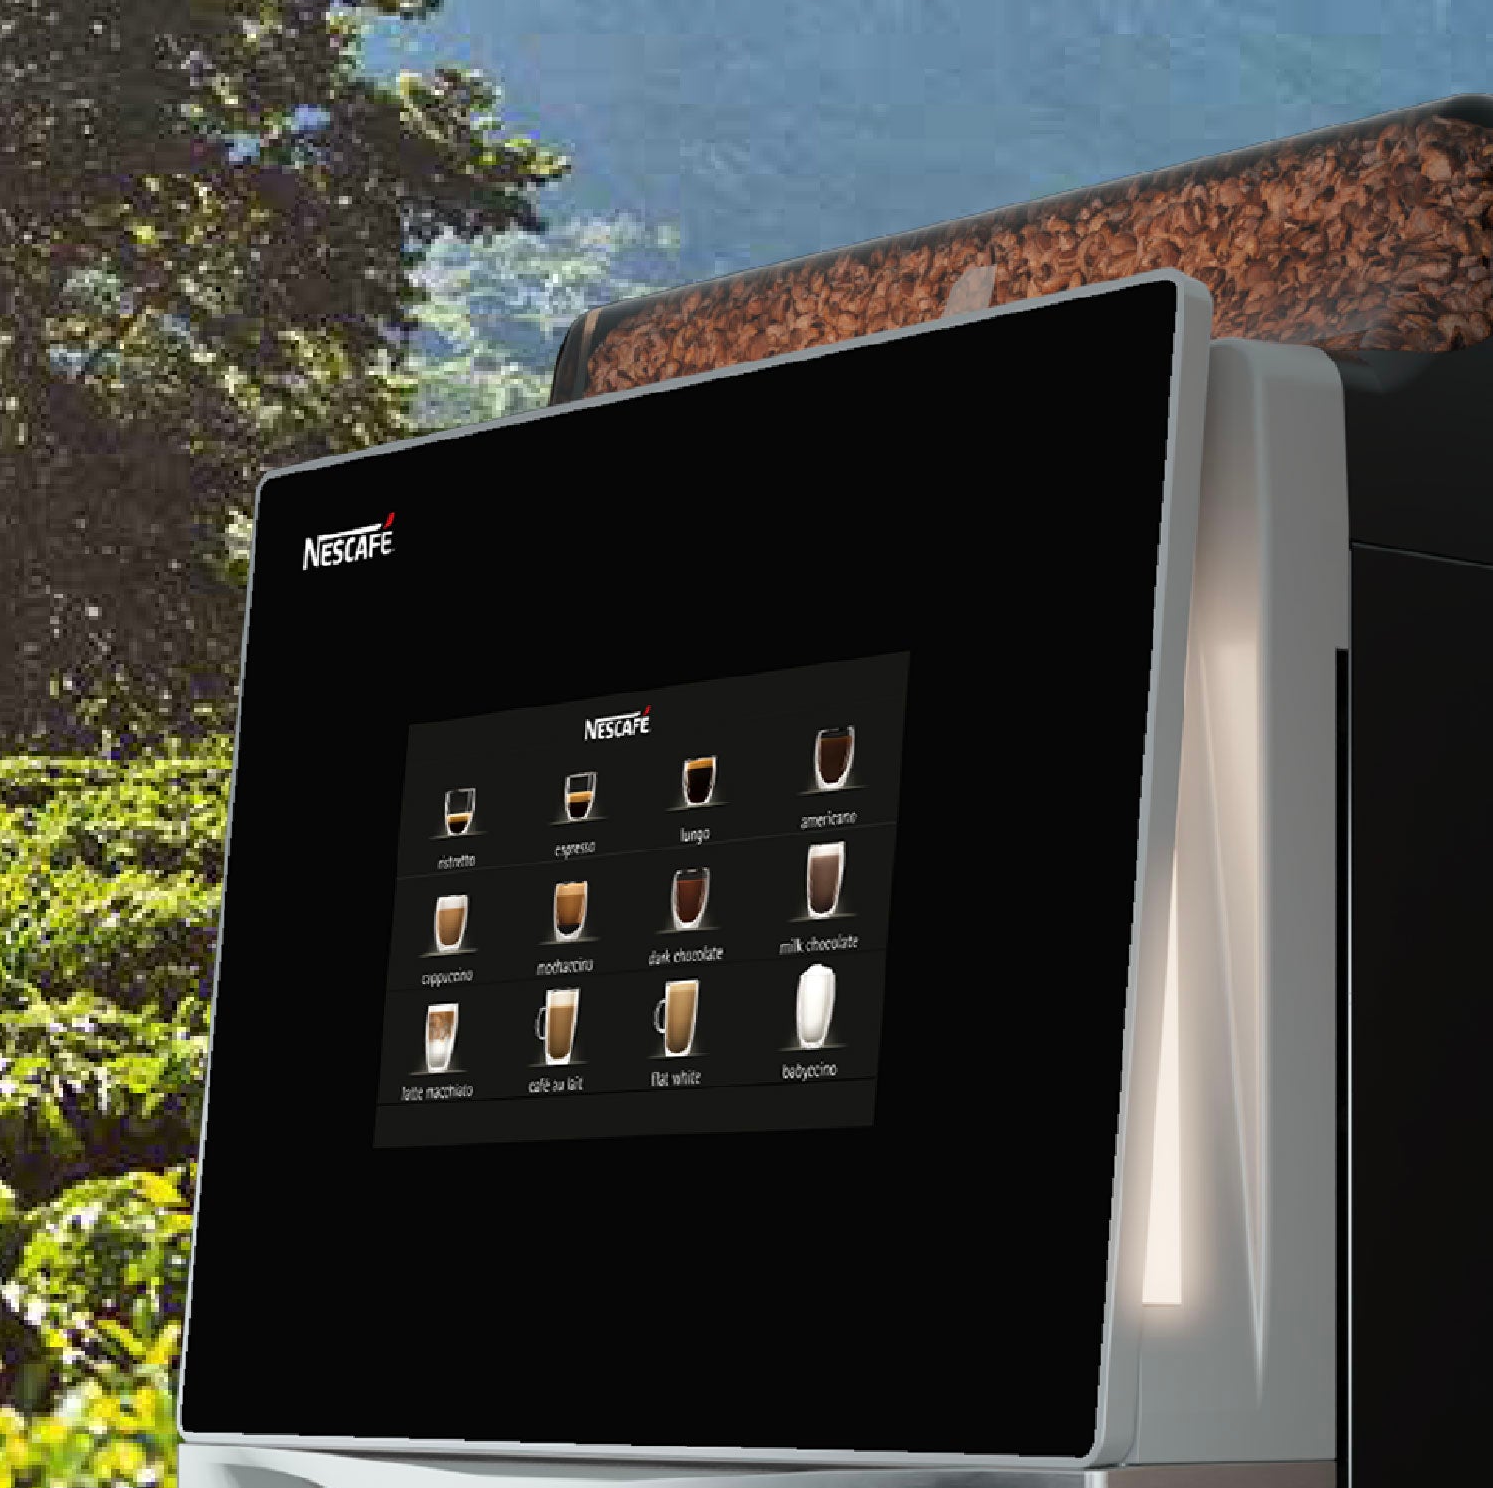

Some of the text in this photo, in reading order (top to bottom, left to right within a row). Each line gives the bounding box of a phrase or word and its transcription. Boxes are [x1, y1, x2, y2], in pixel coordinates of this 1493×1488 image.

[302, 511, 395, 571] NESCAFÉ
[584, 704, 652, 741] NESCAFÉ
[800, 810, 857, 830] americano
[679, 827, 711, 845] lungo
[555, 841, 596, 860] espresso
[779, 933, 859, 955] milk chocolate
[648, 944, 724, 966] dark chocolate
[552, 1078, 565, 1092] au
[650, 1069, 702, 1087] flat white
